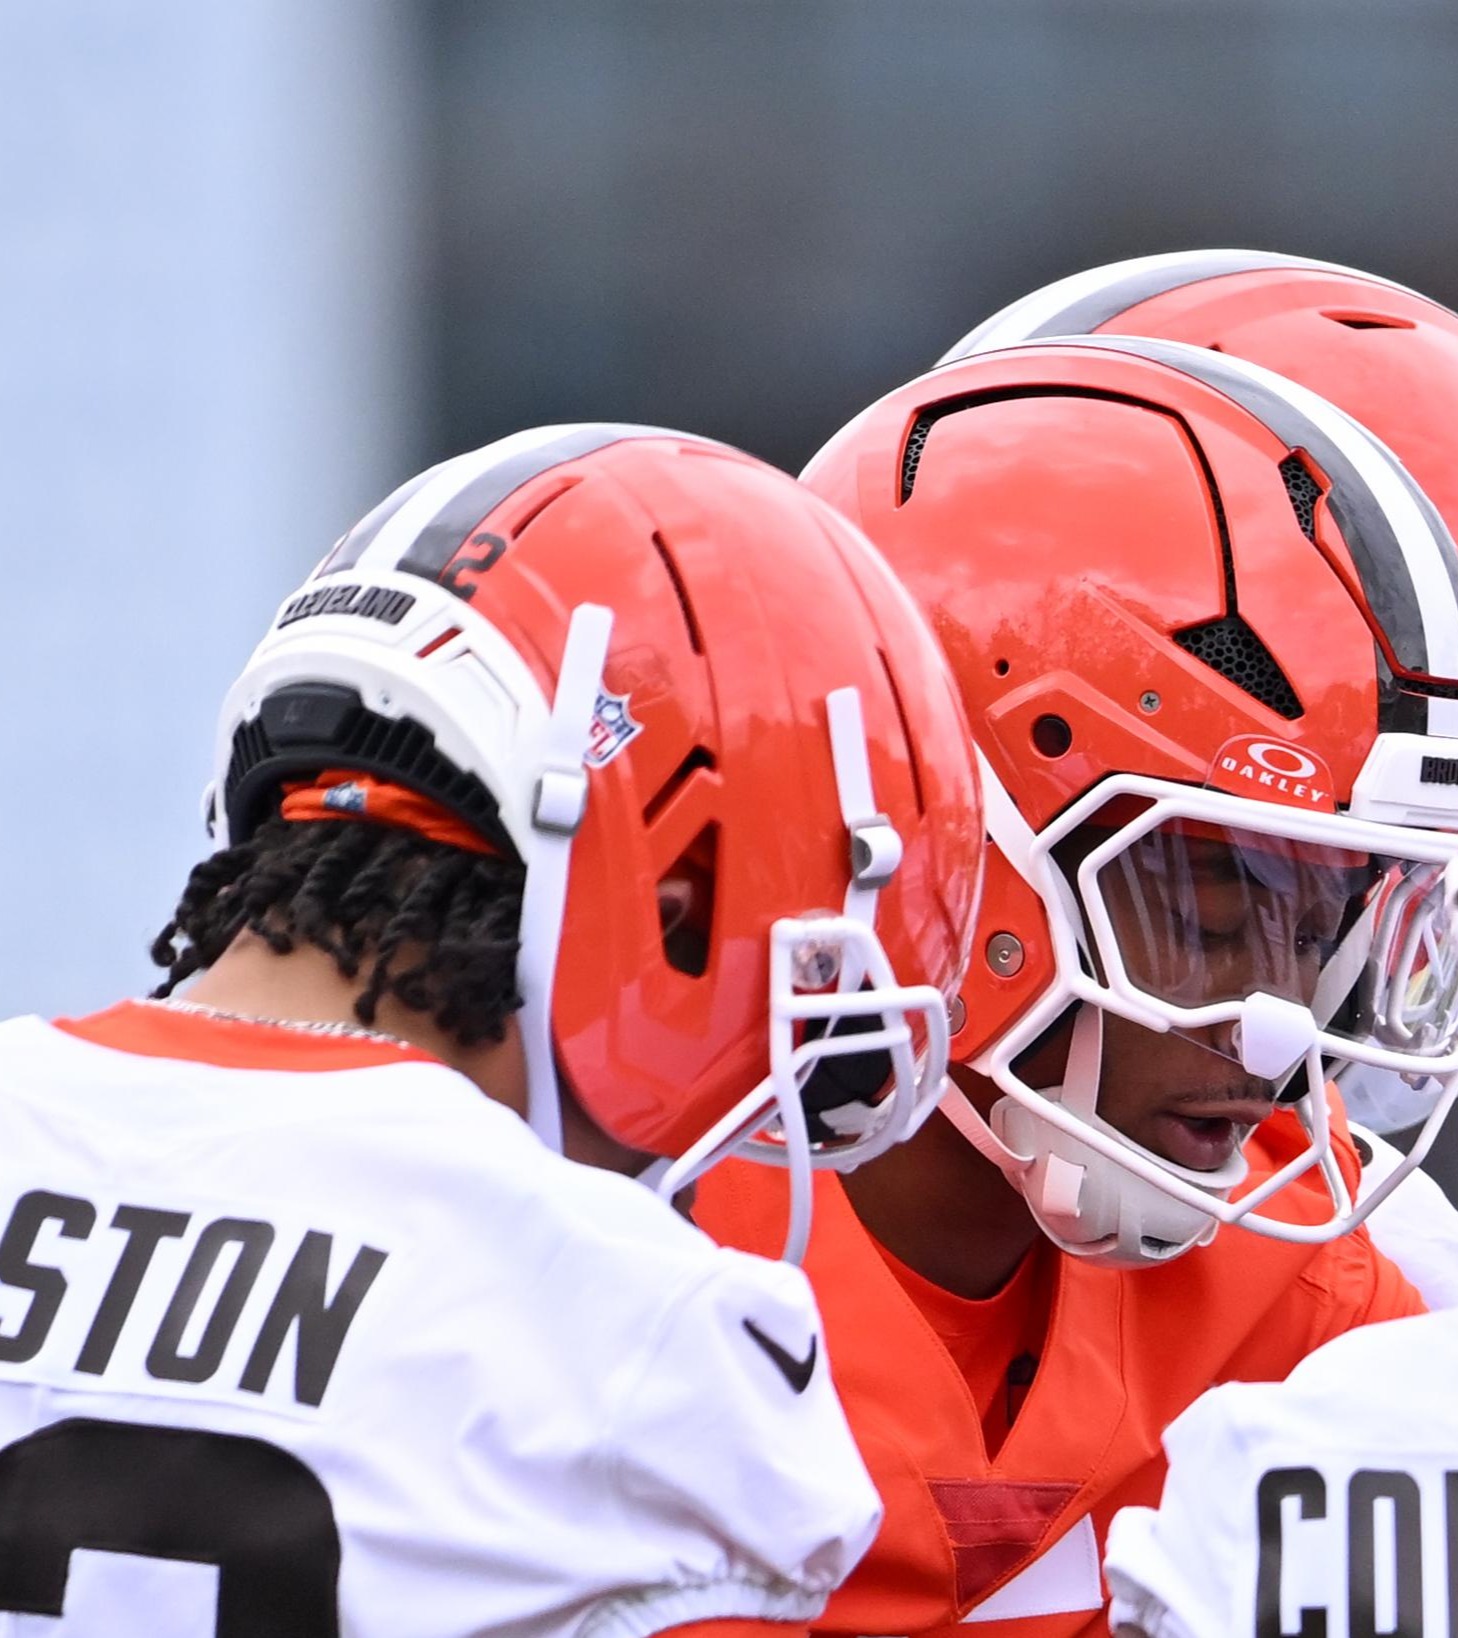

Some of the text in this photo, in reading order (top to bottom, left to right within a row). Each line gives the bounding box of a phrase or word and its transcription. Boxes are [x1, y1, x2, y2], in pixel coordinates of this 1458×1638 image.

[440, 532, 507, 601] 2
[1221, 756, 1327, 803] OAKLEY
[0, 1189, 390, 1408] STON
